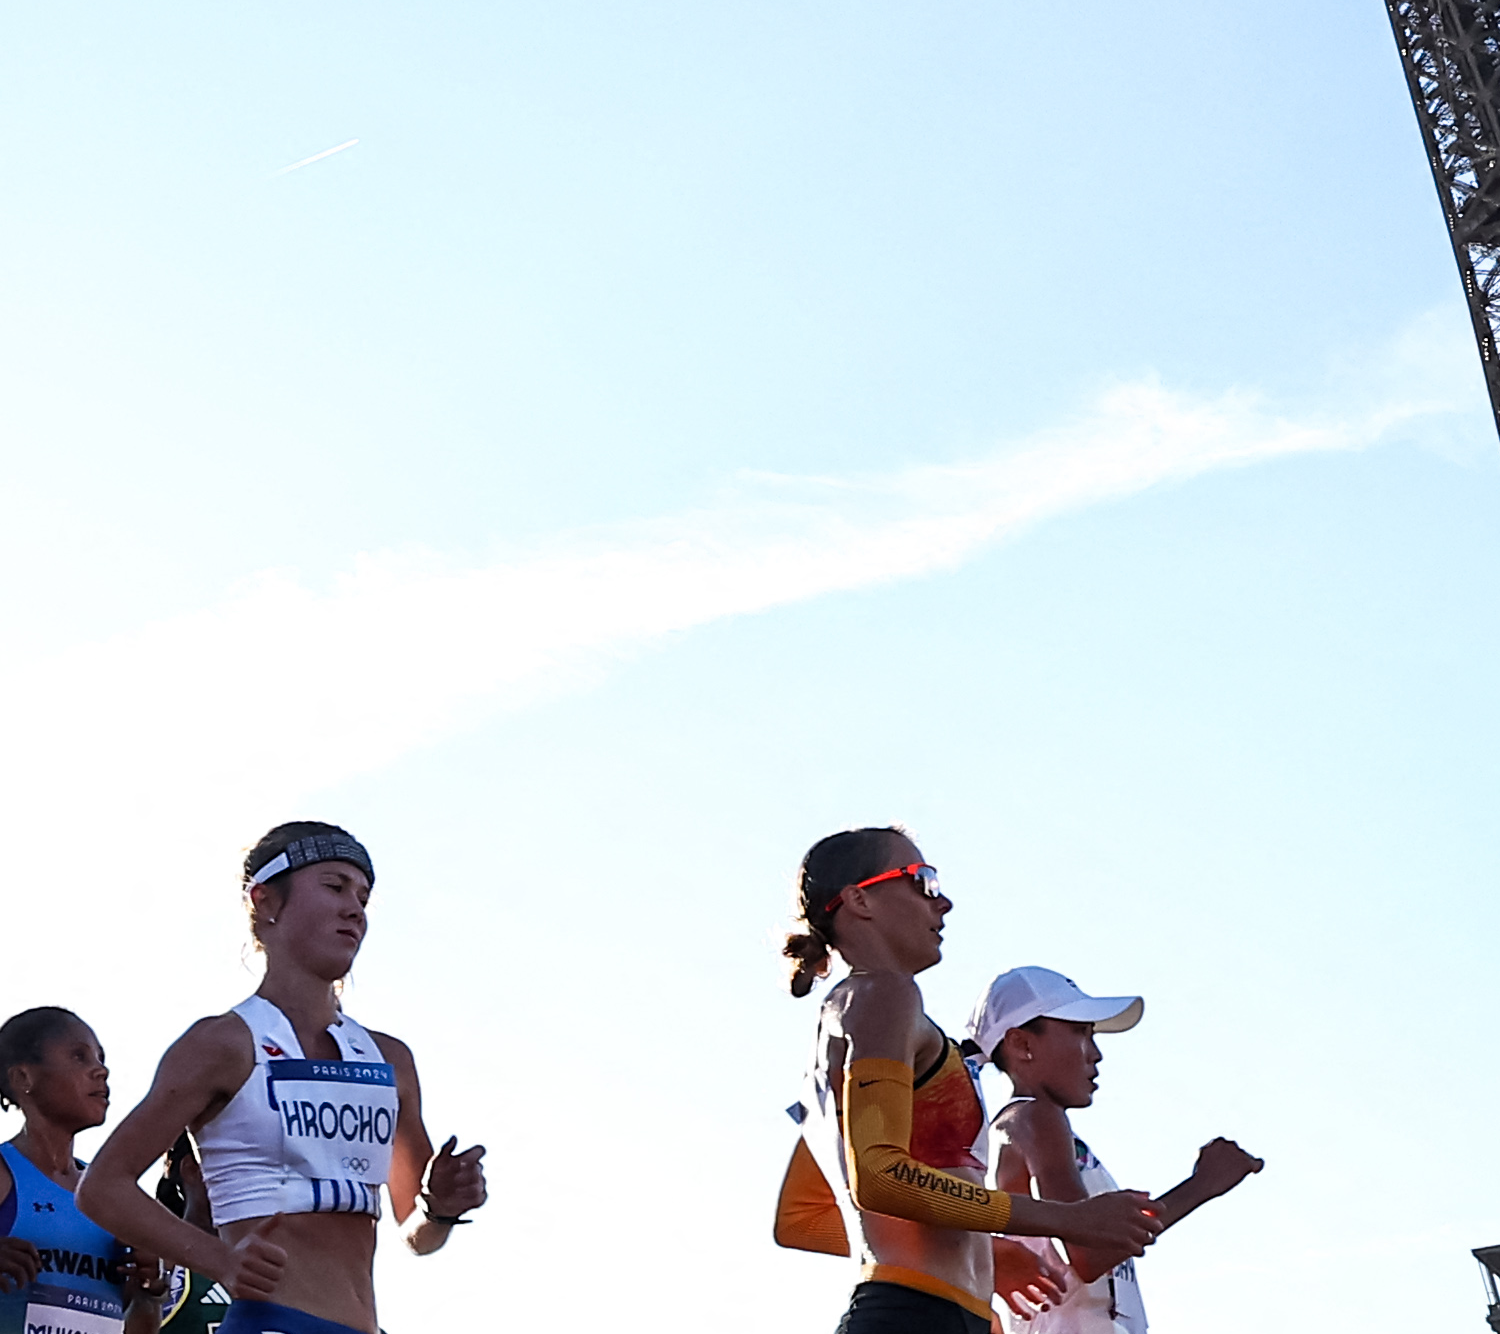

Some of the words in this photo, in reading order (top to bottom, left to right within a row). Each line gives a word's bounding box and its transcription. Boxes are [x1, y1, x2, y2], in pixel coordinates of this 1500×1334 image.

[312, 1065, 351, 1077] PARIS
[354, 1068, 388, 1080] 2024
[886, 1162, 990, 1205] GERMANY
[67, 1294, 98, 1309] PARIS
